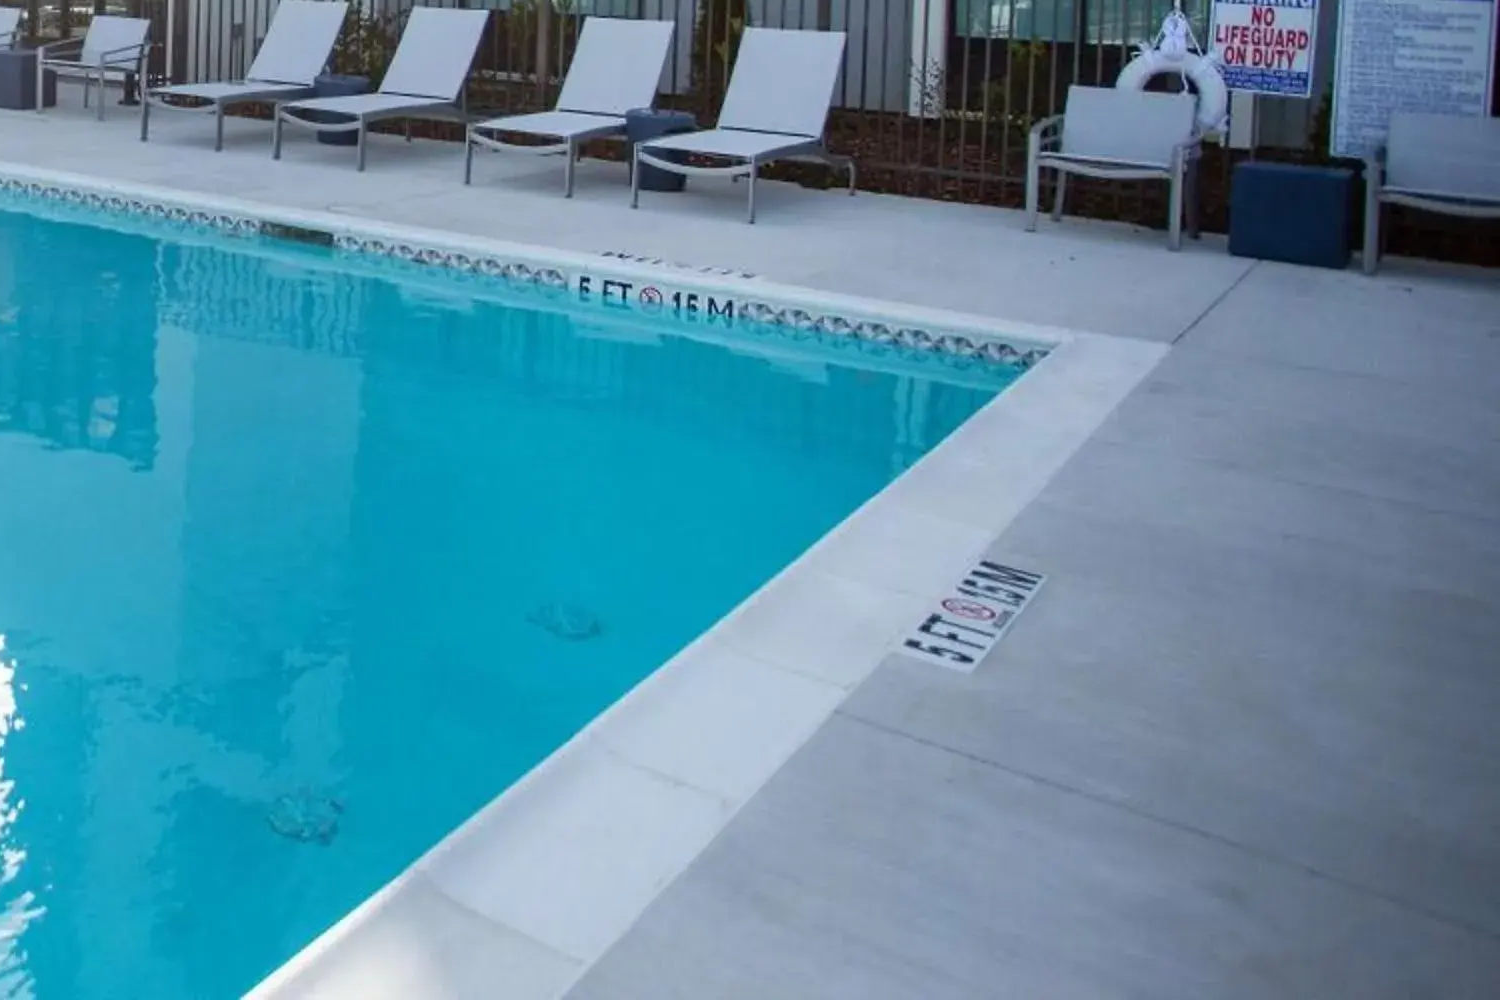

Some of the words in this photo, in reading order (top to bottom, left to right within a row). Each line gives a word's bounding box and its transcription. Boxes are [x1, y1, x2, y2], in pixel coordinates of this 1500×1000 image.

[1251, 7, 1275, 27] NO
[1216, 25, 1309, 50] LIFEGUARD
[1224, 46, 1246, 65] ON
[1252, 47, 1296, 70] DUTY
[603, 279, 633, 306] FT
[917, 612, 996, 650] FT
[903, 637, 975, 664] 5
